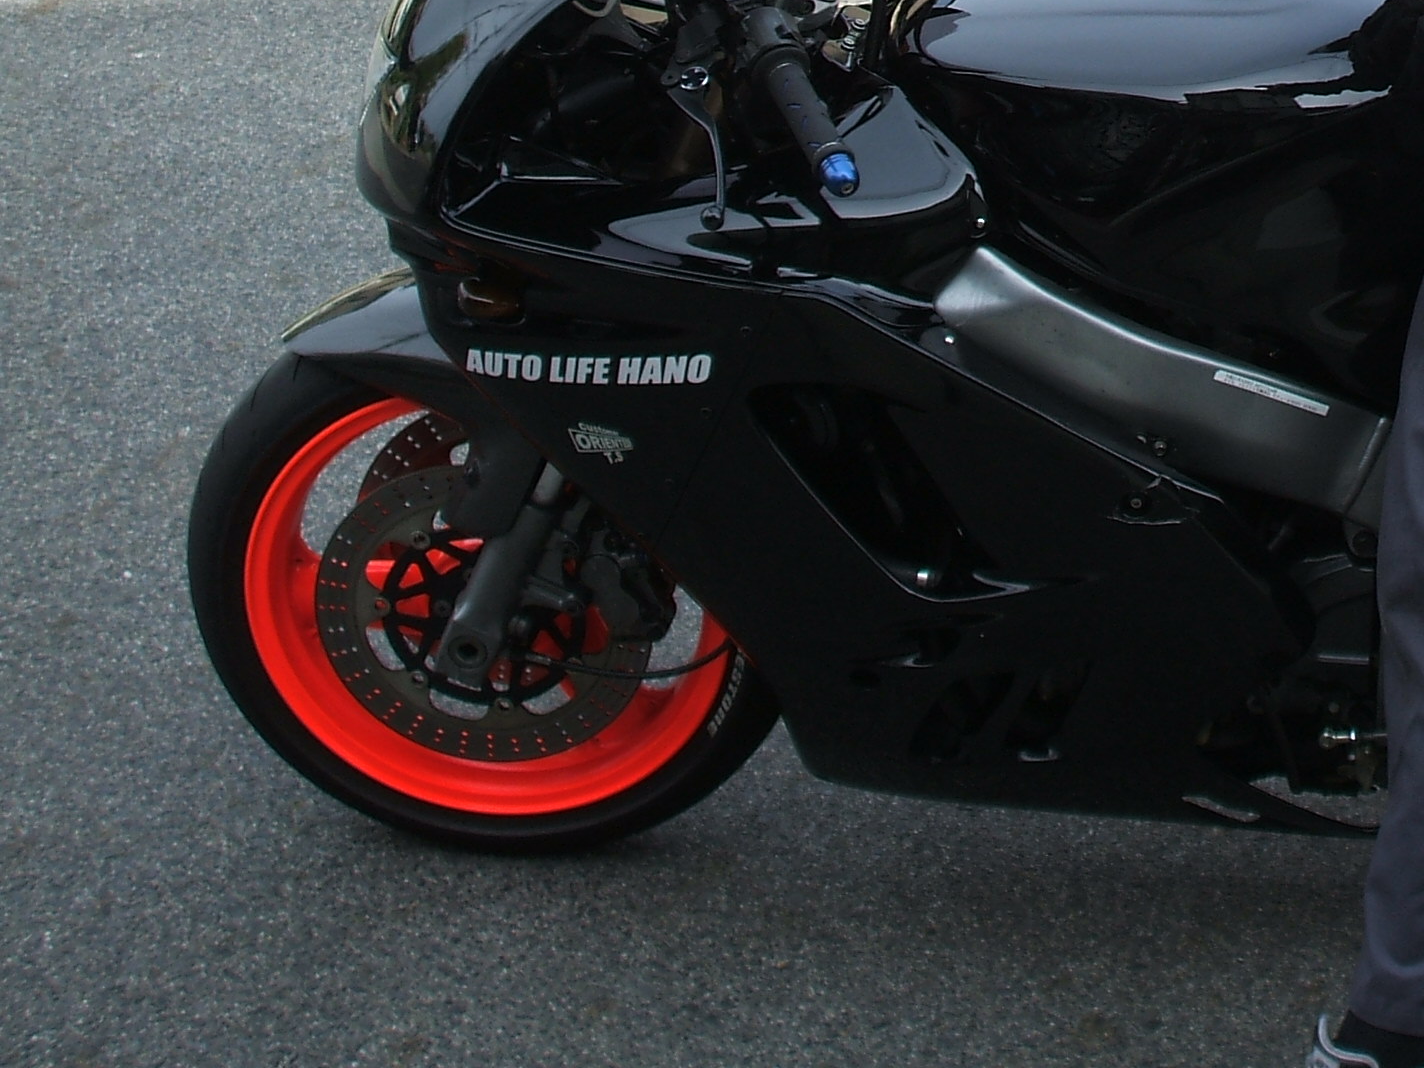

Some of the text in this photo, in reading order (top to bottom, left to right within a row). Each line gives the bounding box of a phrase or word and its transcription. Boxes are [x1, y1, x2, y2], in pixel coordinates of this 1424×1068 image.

[466, 348, 713, 384] AUTO LIFE HANO
